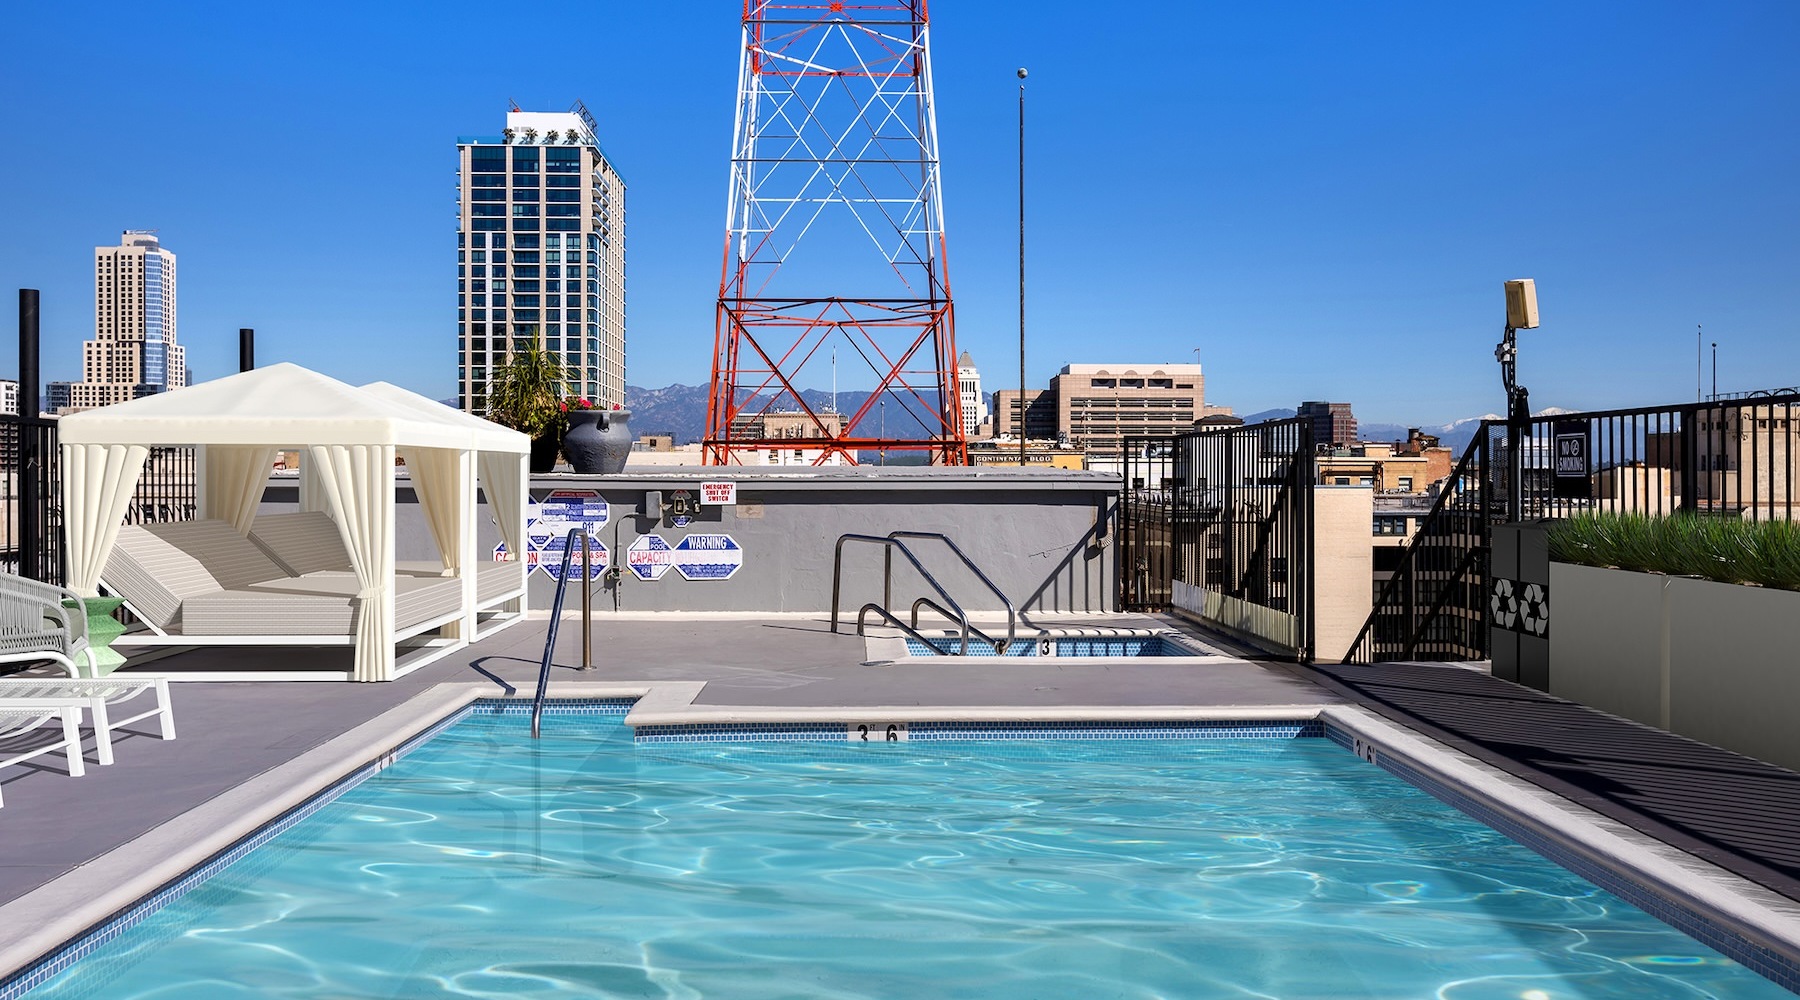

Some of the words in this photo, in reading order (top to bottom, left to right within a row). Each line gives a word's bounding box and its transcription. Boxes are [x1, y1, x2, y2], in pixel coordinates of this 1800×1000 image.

[1561, 441, 1570, 455] NO
[1559, 457, 1583, 471] SMOKING
[687, 536, 727, 549] WARNING
[629, 551, 671, 564] CAPACITY
[1042, 639, 1050, 656] 3
[857, 724, 868, 742] 3
[886, 724, 898, 742] 6
